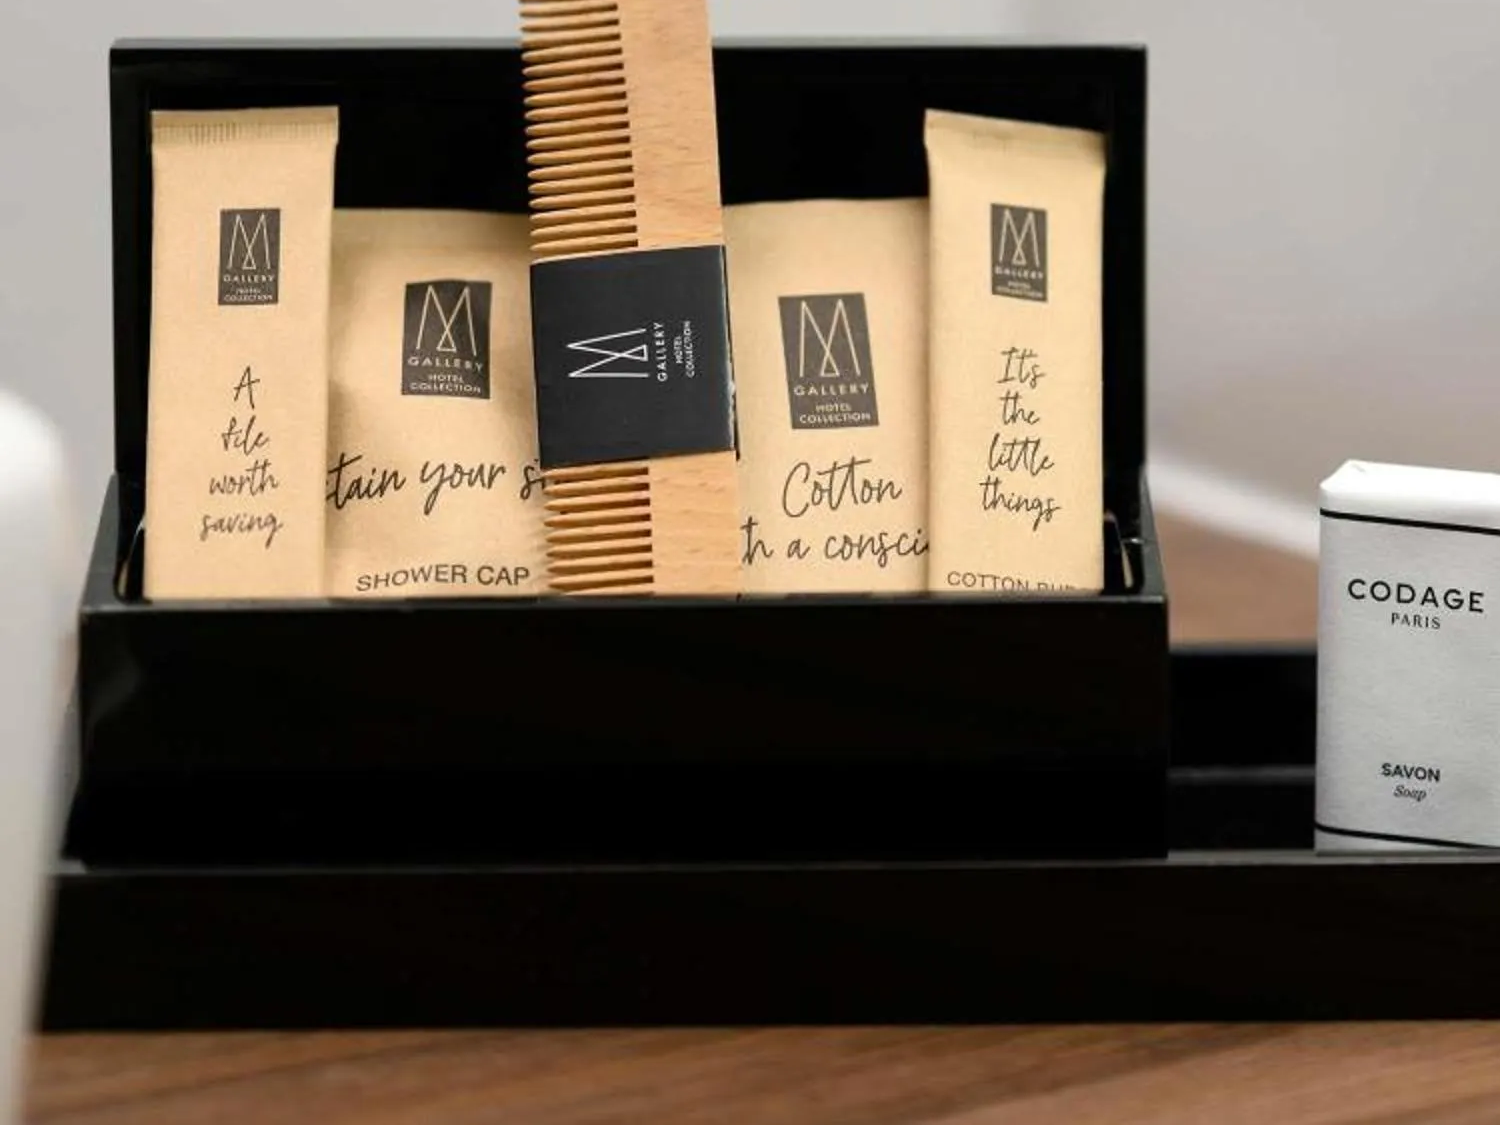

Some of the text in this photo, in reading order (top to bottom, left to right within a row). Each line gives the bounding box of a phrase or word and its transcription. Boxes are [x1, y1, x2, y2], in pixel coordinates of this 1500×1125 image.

[407, 356, 484, 373] GALLERY
[653, 322, 669, 382] GALLERY
[997, 346, 1047, 389] It's
[233, 365, 261, 410] A
[793, 382, 869, 396] GALLERY
[799, 411, 872, 424] COLLECTION
[999, 389, 1041, 426] the
[221, 415, 269, 457] file
[988, 432, 1055, 476] little
[208, 458, 280, 497] worth
[325, 452, 406, 510] tain
[418, 460, 506, 516] your
[782, 456, 903, 518] Cotton
[979, 474, 1062, 532] things
[199, 512, 283, 550] saving
[786, 538, 812, 560] a
[824, 528, 930, 569] consci
[355, 564, 531, 592] SHOWER CAP
[947, 570, 1030, 592] COTTON
[1348, 578, 1485, 613] CODAGE
[1391, 611, 1441, 630] PARIS
[1381, 762, 1441, 783] SAVON
[1393, 784, 1428, 802] Soap
